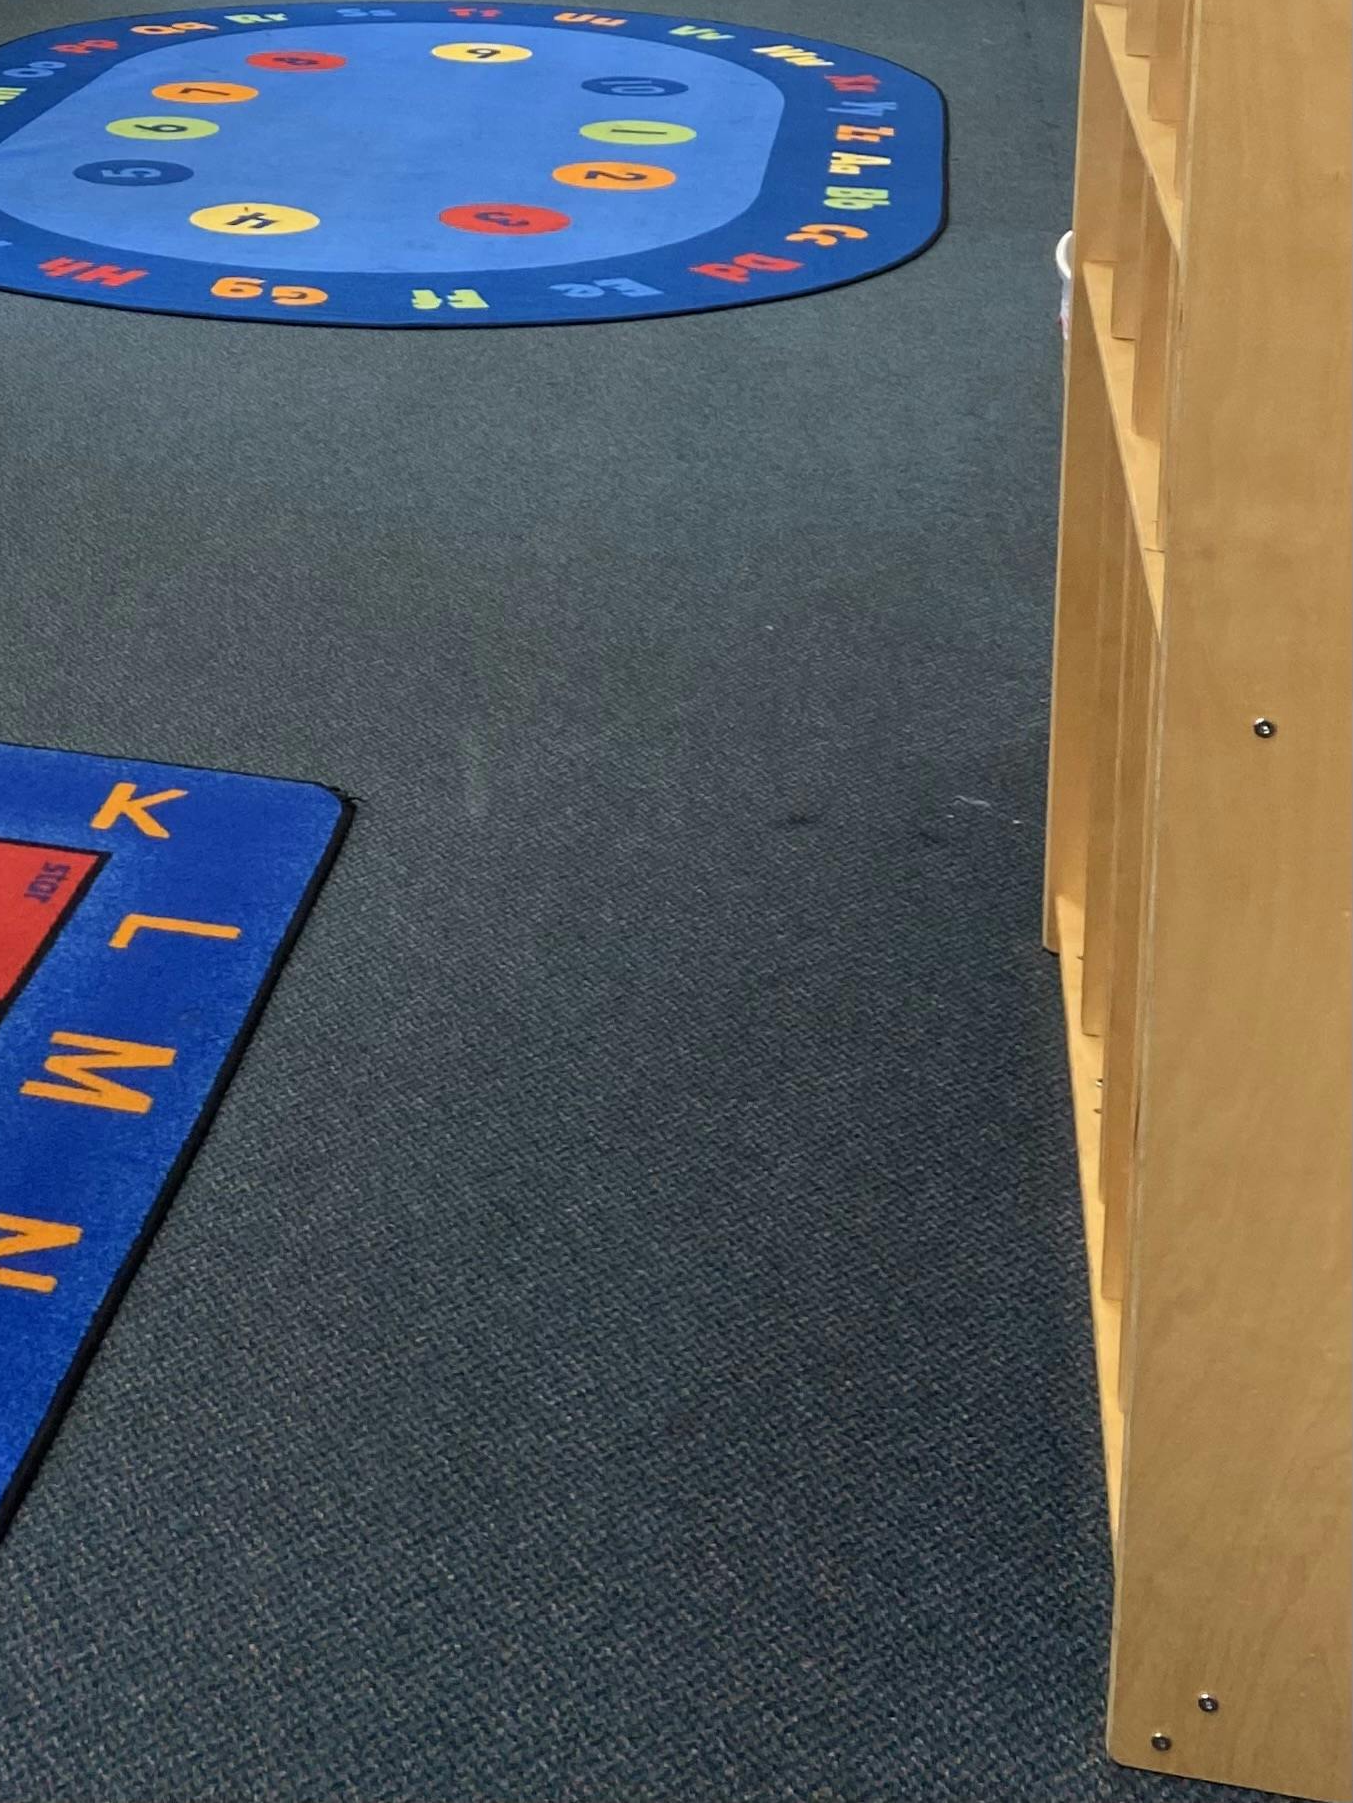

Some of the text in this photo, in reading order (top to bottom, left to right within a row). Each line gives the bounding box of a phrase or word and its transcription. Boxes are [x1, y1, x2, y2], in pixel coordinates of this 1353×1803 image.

[131, 21, 219, 36] Qq
[225, 13, 287, 25] Rr
[554, 12, 627, 26] Uu
[668, 25, 734, 41] Vv
[466, 47, 501, 59] 9
[2, 60, 66, 78] Oo
[181, 88, 231, 97] 7
[134, 123, 188, 133] 6
[101, 164, 161, 180] 5
[828, 151, 891, 174] Aa
[585, 169, 646, 182] 2
[824, 186, 889, 209] Bb
[226, 209, 279, 229] 4
[475, 211, 528, 228] 3
[785, 223, 869, 246] Cc
[39, 256, 148, 286] Hh
[689, 253, 804, 283] Dd
[210, 276, 328, 306] Gg
[549, 277, 663, 298] Ee
[411, 288, 489, 310] Ff
[91, 782, 188, 839] K
[24, 860, 71, 903] star
[108, 913, 241, 950] L
[18, 1031, 178, 1116] M
